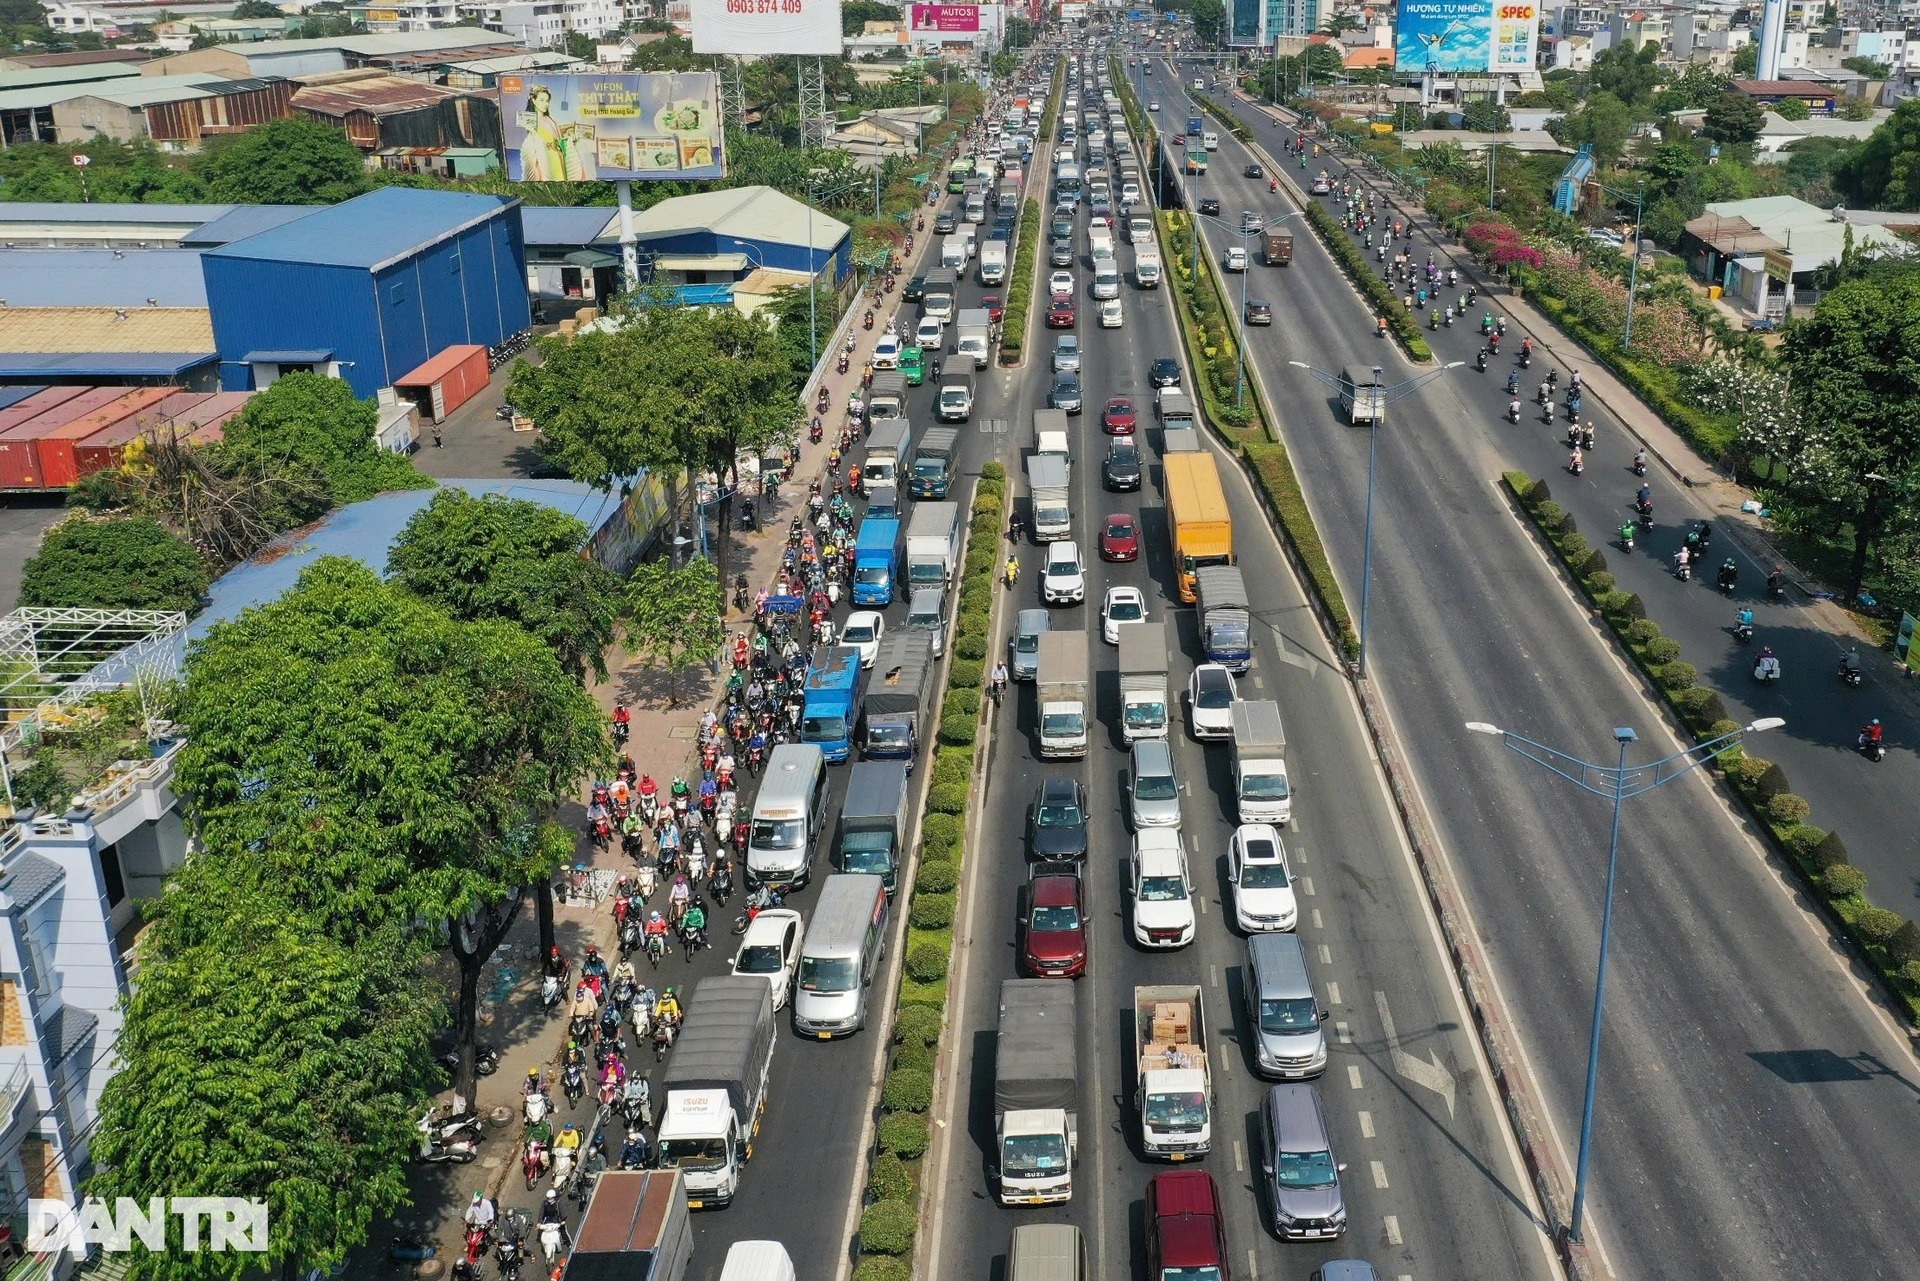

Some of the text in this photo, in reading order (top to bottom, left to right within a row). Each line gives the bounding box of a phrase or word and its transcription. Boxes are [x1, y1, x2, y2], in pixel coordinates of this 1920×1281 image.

[727, 0, 802, 13] 0903 874 409
[1406, 4, 1485, 14] HƯƠNG TỰ NHIÊN
[941, 8, 974, 17] MUTOSI
[1501, 6, 1531, 19] SPEC
[593, 82, 623, 91] VIFON
[683, 1097, 708, 1105] ISUZU
